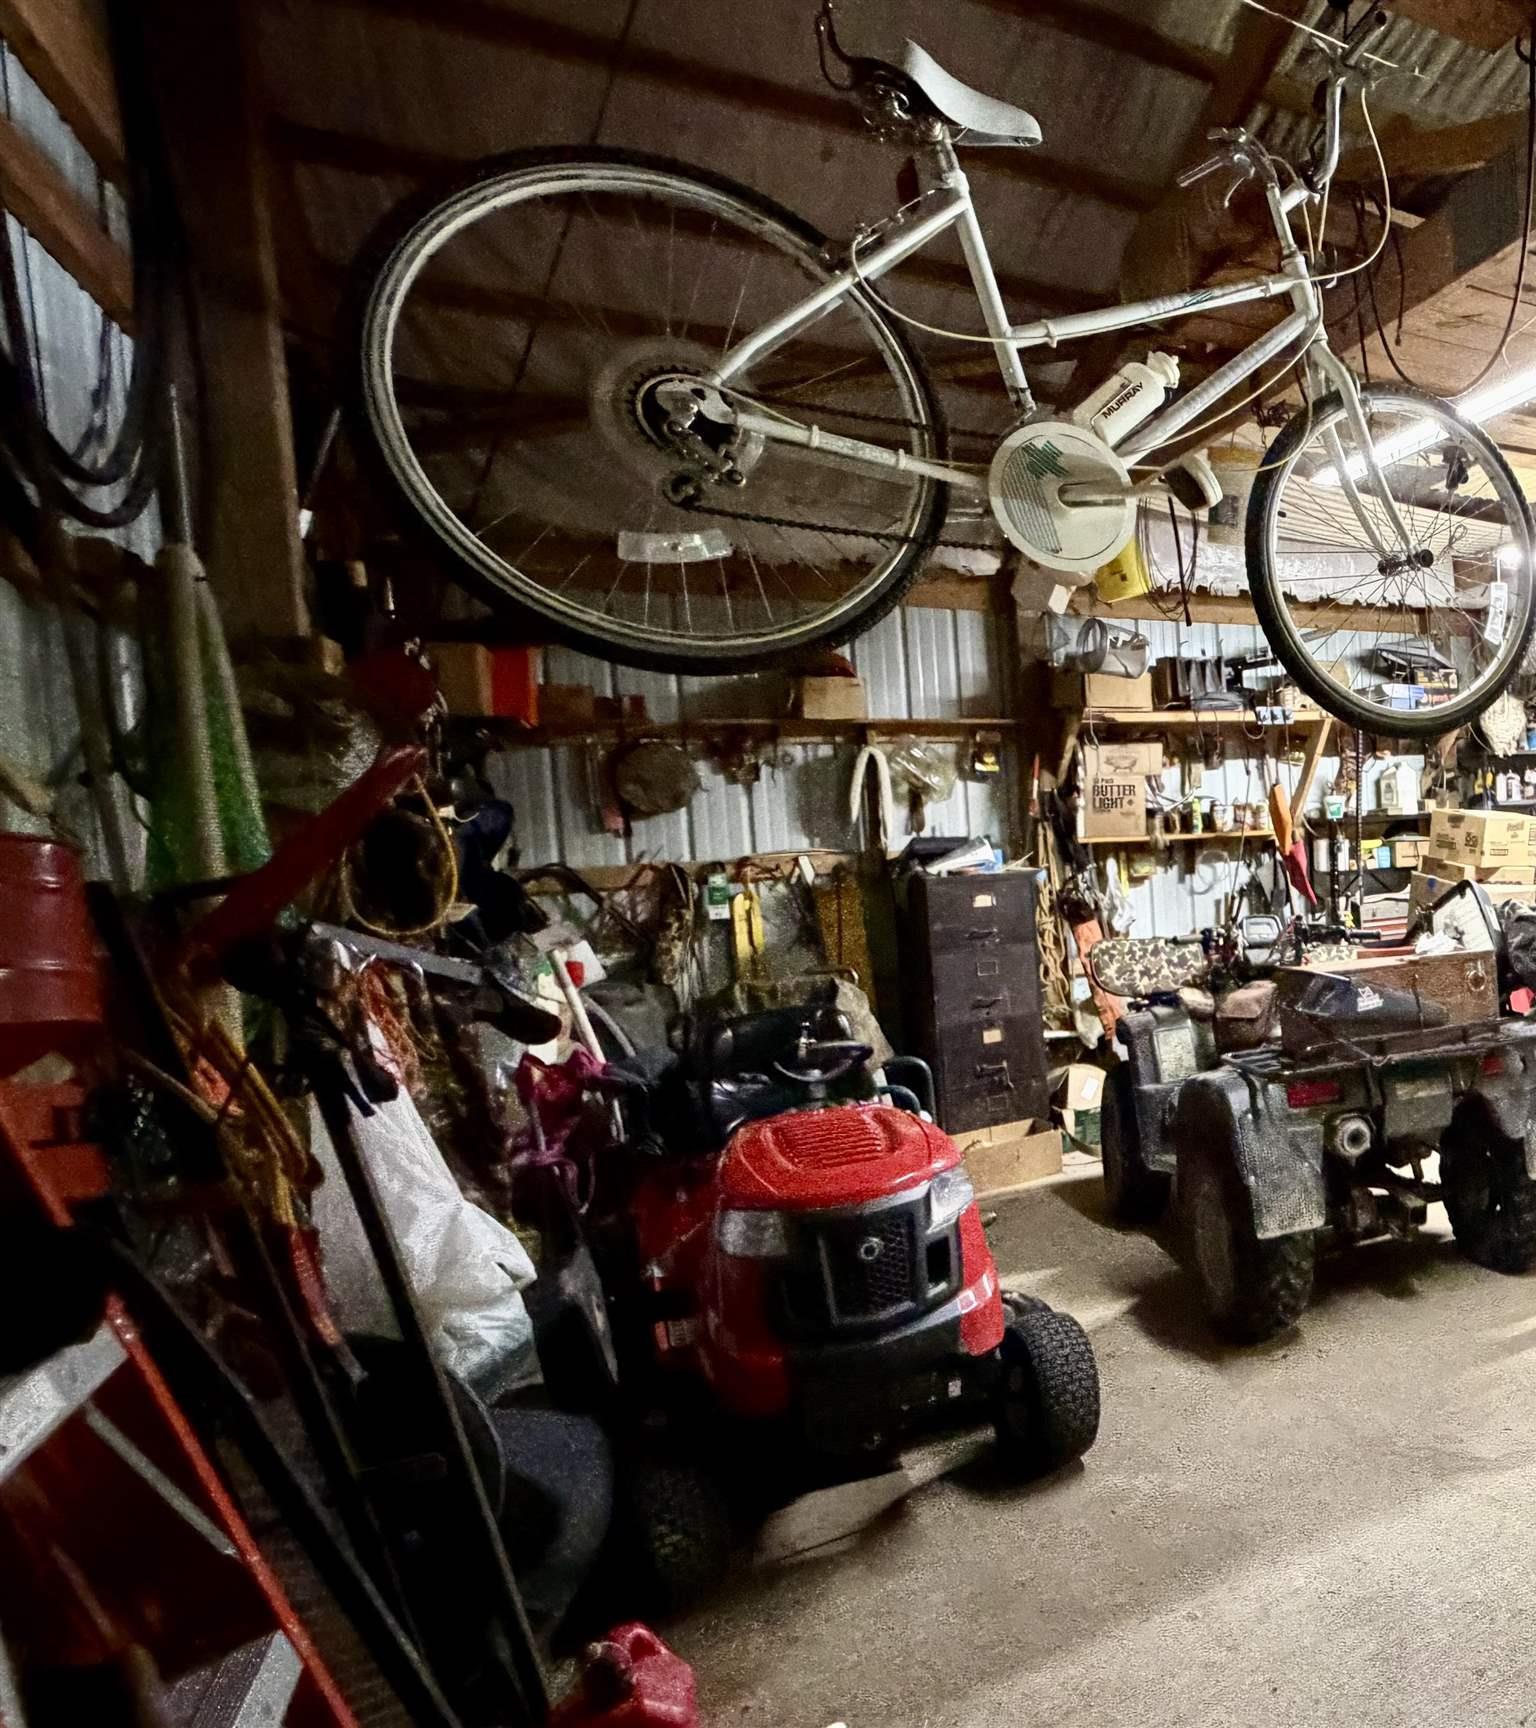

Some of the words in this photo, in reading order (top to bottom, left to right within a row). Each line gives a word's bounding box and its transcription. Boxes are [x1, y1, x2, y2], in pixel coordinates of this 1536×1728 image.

[1101, 382, 1143, 419] MURRAY
[1092, 785, 1136, 797] BUTTER
[1093, 797, 1125, 809] LIGHT
